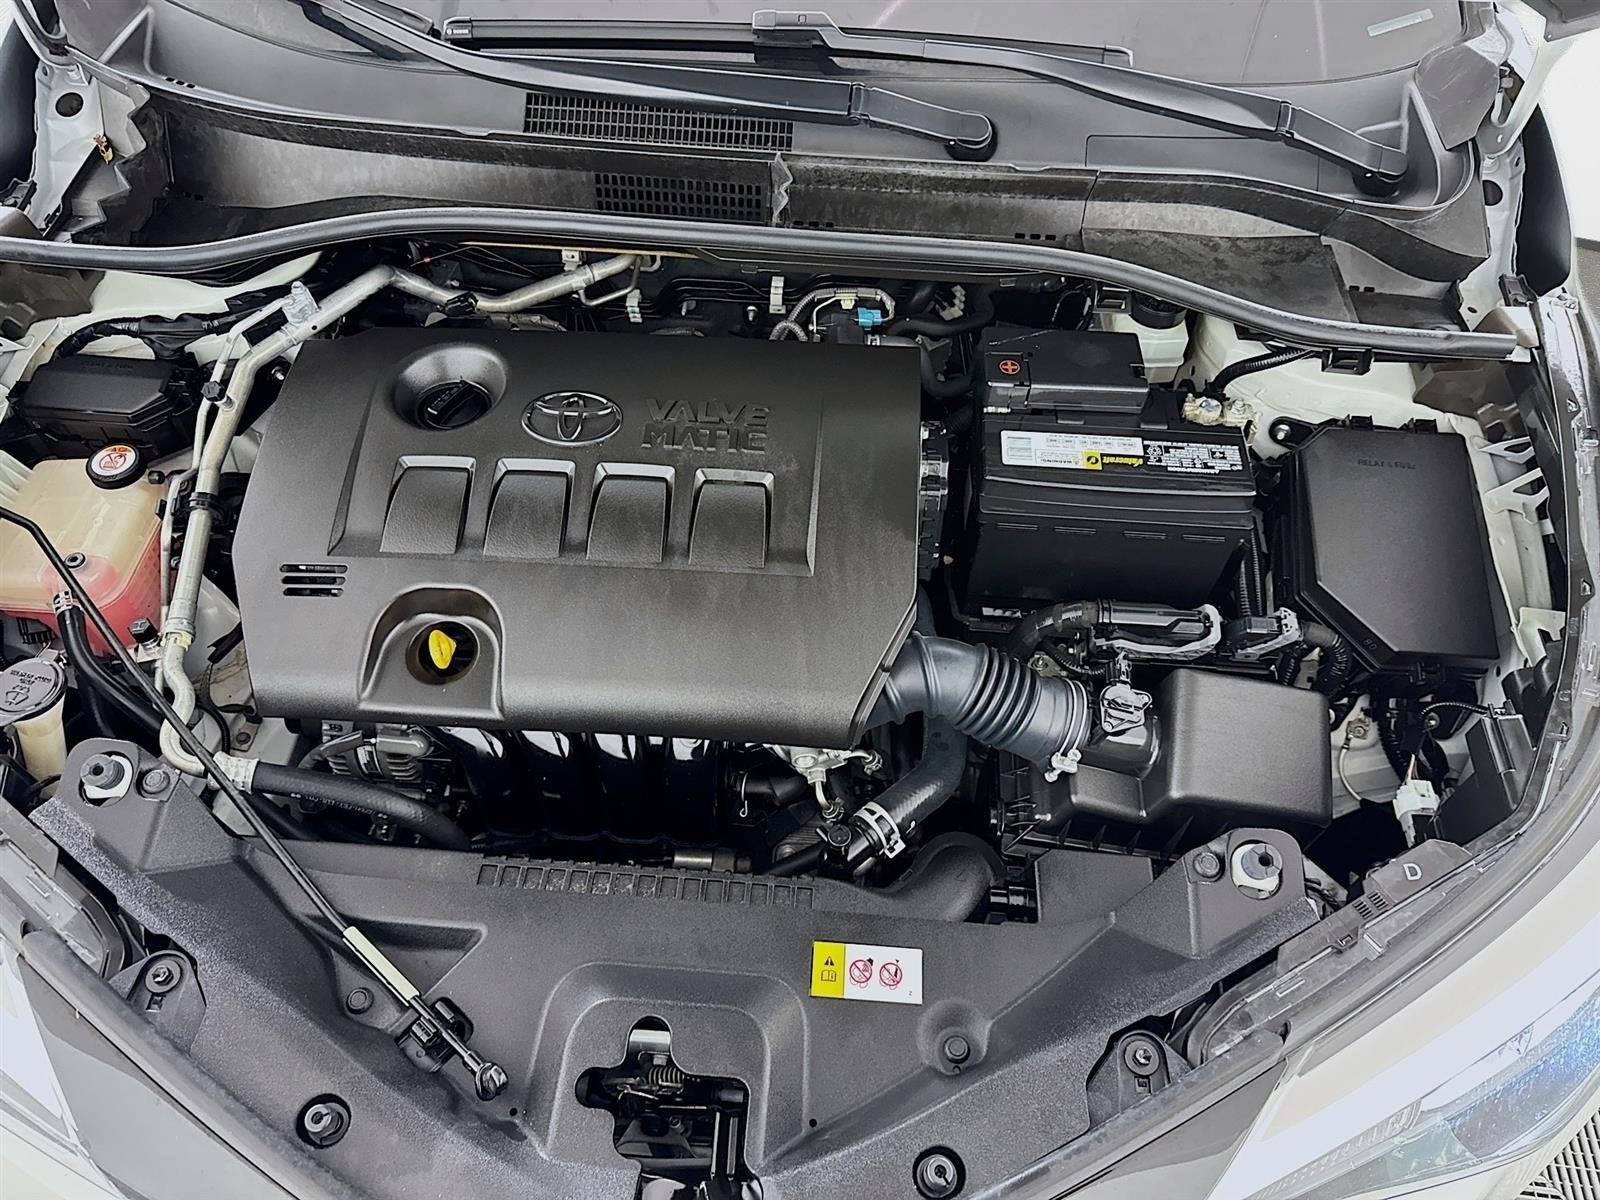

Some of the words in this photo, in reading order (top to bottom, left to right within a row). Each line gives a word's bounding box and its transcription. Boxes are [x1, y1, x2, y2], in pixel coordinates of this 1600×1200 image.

[647, 399, 769, 427] VALVE
[641, 424, 767, 454] MATIC
[1403, 862, 1422, 881] D
